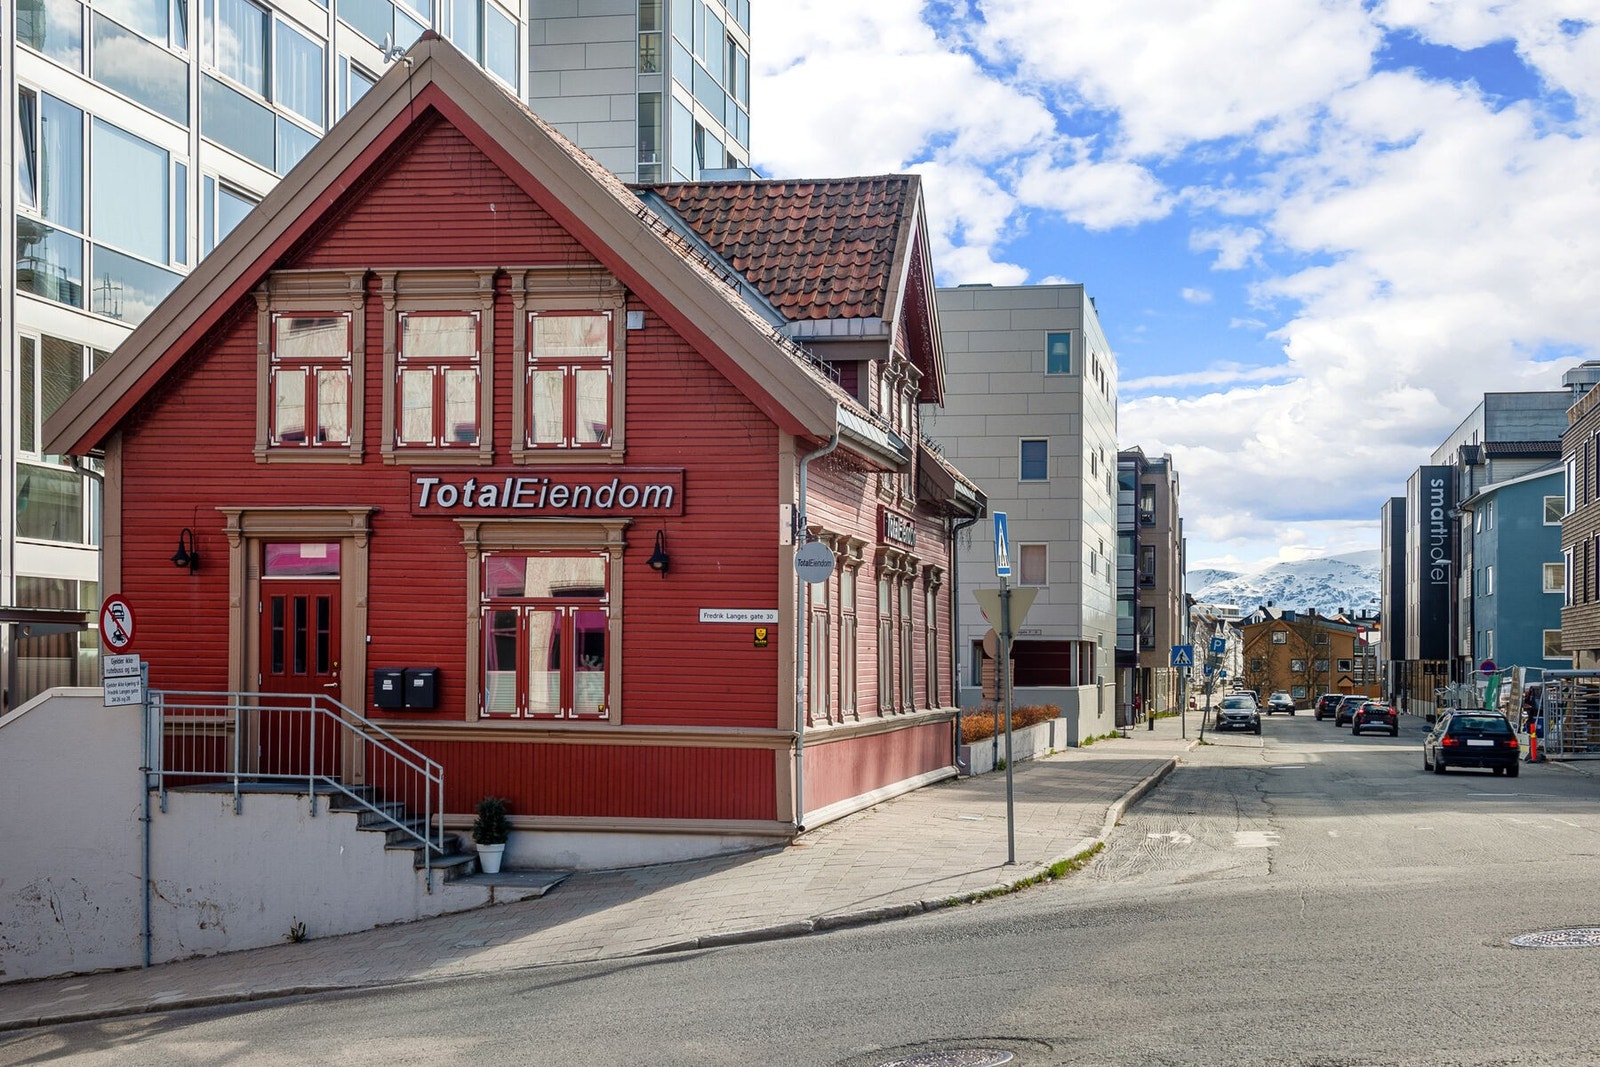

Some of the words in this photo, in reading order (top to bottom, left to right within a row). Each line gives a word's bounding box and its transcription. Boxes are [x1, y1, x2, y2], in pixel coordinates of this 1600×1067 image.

[415, 477, 674, 509] TotalEiendom
[797, 558, 831, 568] TotalEiendom
[1213, 639, 1222, 651] P
